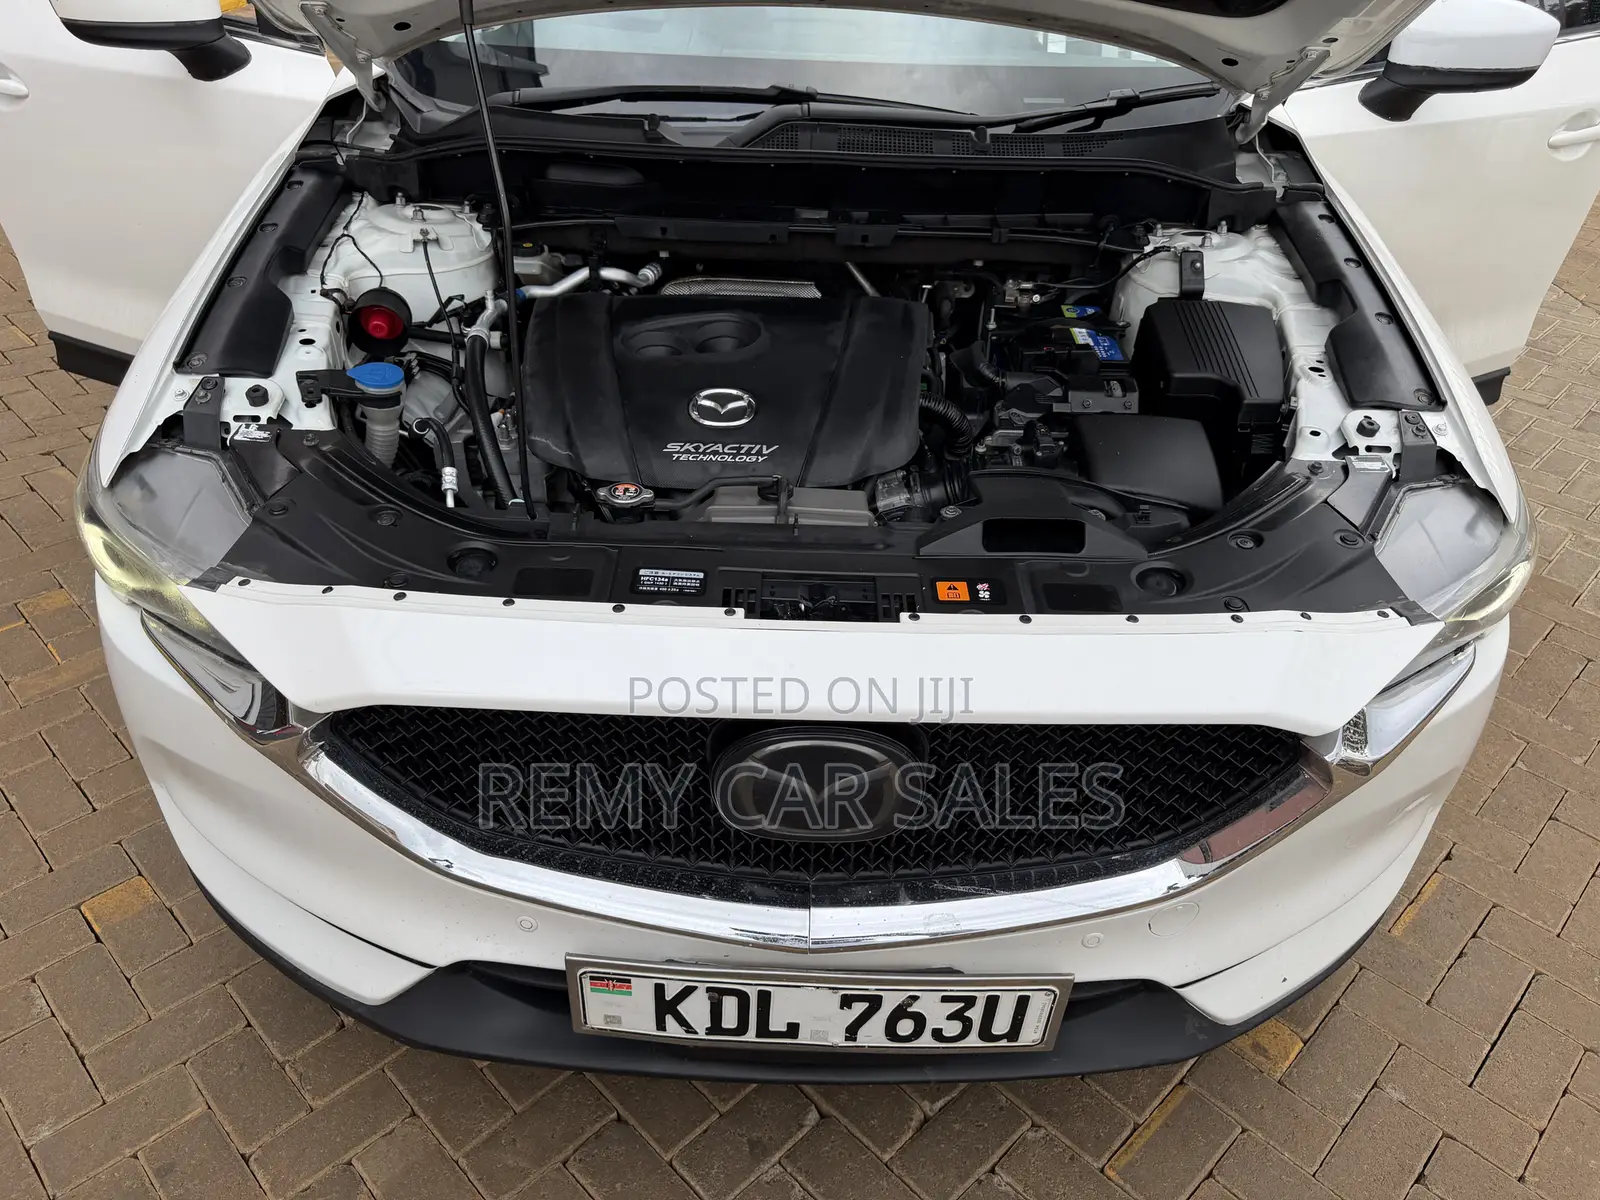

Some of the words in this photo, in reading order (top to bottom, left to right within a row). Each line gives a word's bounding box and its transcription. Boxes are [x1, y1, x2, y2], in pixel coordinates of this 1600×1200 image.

[662, 442, 779, 454] SKYACTIV
[672, 453, 768, 462] TECHNOLOGY
[654, 982, 801, 1039] KDL
[839, 993, 1031, 1043] 763U
